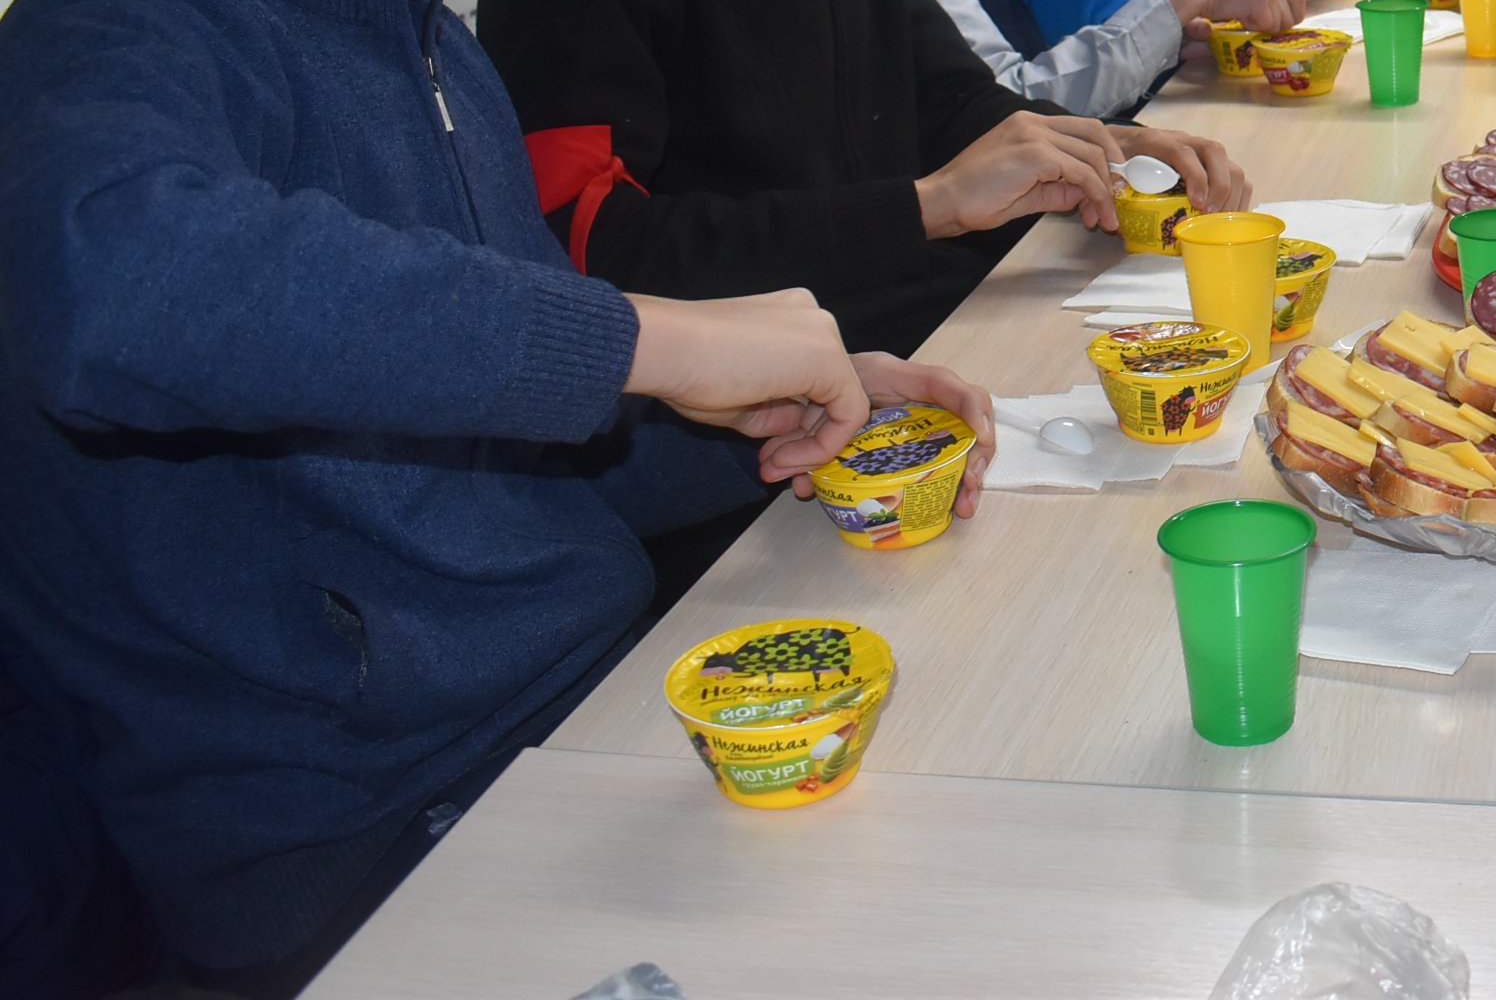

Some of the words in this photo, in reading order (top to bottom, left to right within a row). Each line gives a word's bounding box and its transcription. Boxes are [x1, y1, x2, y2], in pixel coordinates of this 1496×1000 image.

[701, 676, 872, 700] Нежинская
[719, 698, 807, 720] ЙОГУРТ
[712, 735, 810, 754] Нежинская
[730, 759, 810, 783] ЙОГУРТ
